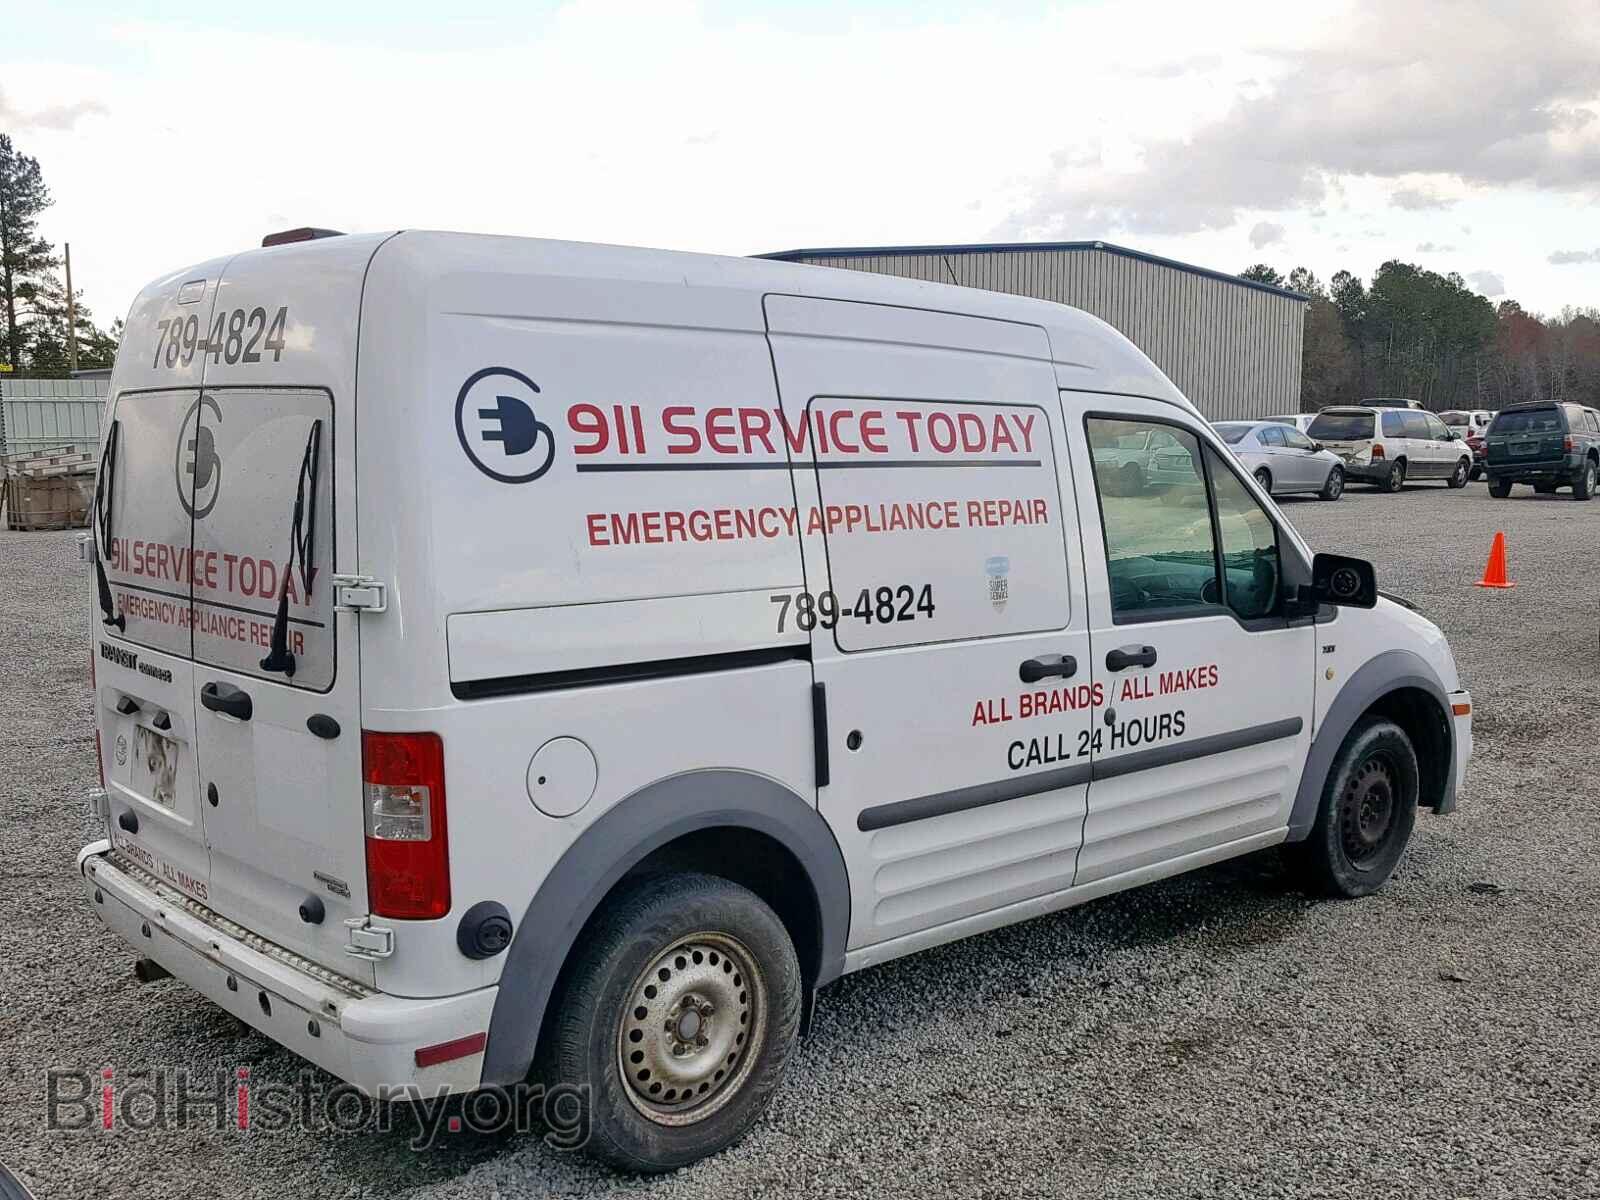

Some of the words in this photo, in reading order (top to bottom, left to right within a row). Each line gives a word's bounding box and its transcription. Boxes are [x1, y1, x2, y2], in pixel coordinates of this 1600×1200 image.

[152, 306, 288, 369] 789-4824
[567, 403, 647, 455] 911
[660, 406, 890, 455] SERVICE
[895, 411, 1036, 454] TODAY
[586, 506, 798, 547] EMERGENCY
[806, 501, 961, 536] APPLIANCE
[966, 499, 1049, 528] REPAIR
[111, 537, 129, 573] 911
[133, 540, 218, 590] SERVICE
[116, 592, 176, 626] EMERGENCY
[177, 606, 246, 642] APPLIANCE
[770, 583, 936, 634] 789-4824
[972, 697, 1013, 727] ALL
[1019, 683, 1105, 719] BRANDS
[1120, 675, 1154, 702] ALL
[1159, 665, 1219, 695] MAKES
[1007, 734, 1070, 770] CALL
[1077, 728, 1103, 757] 24
[1110, 710, 1186, 751] HOURS
[177, 871, 208, 900] MAKES
